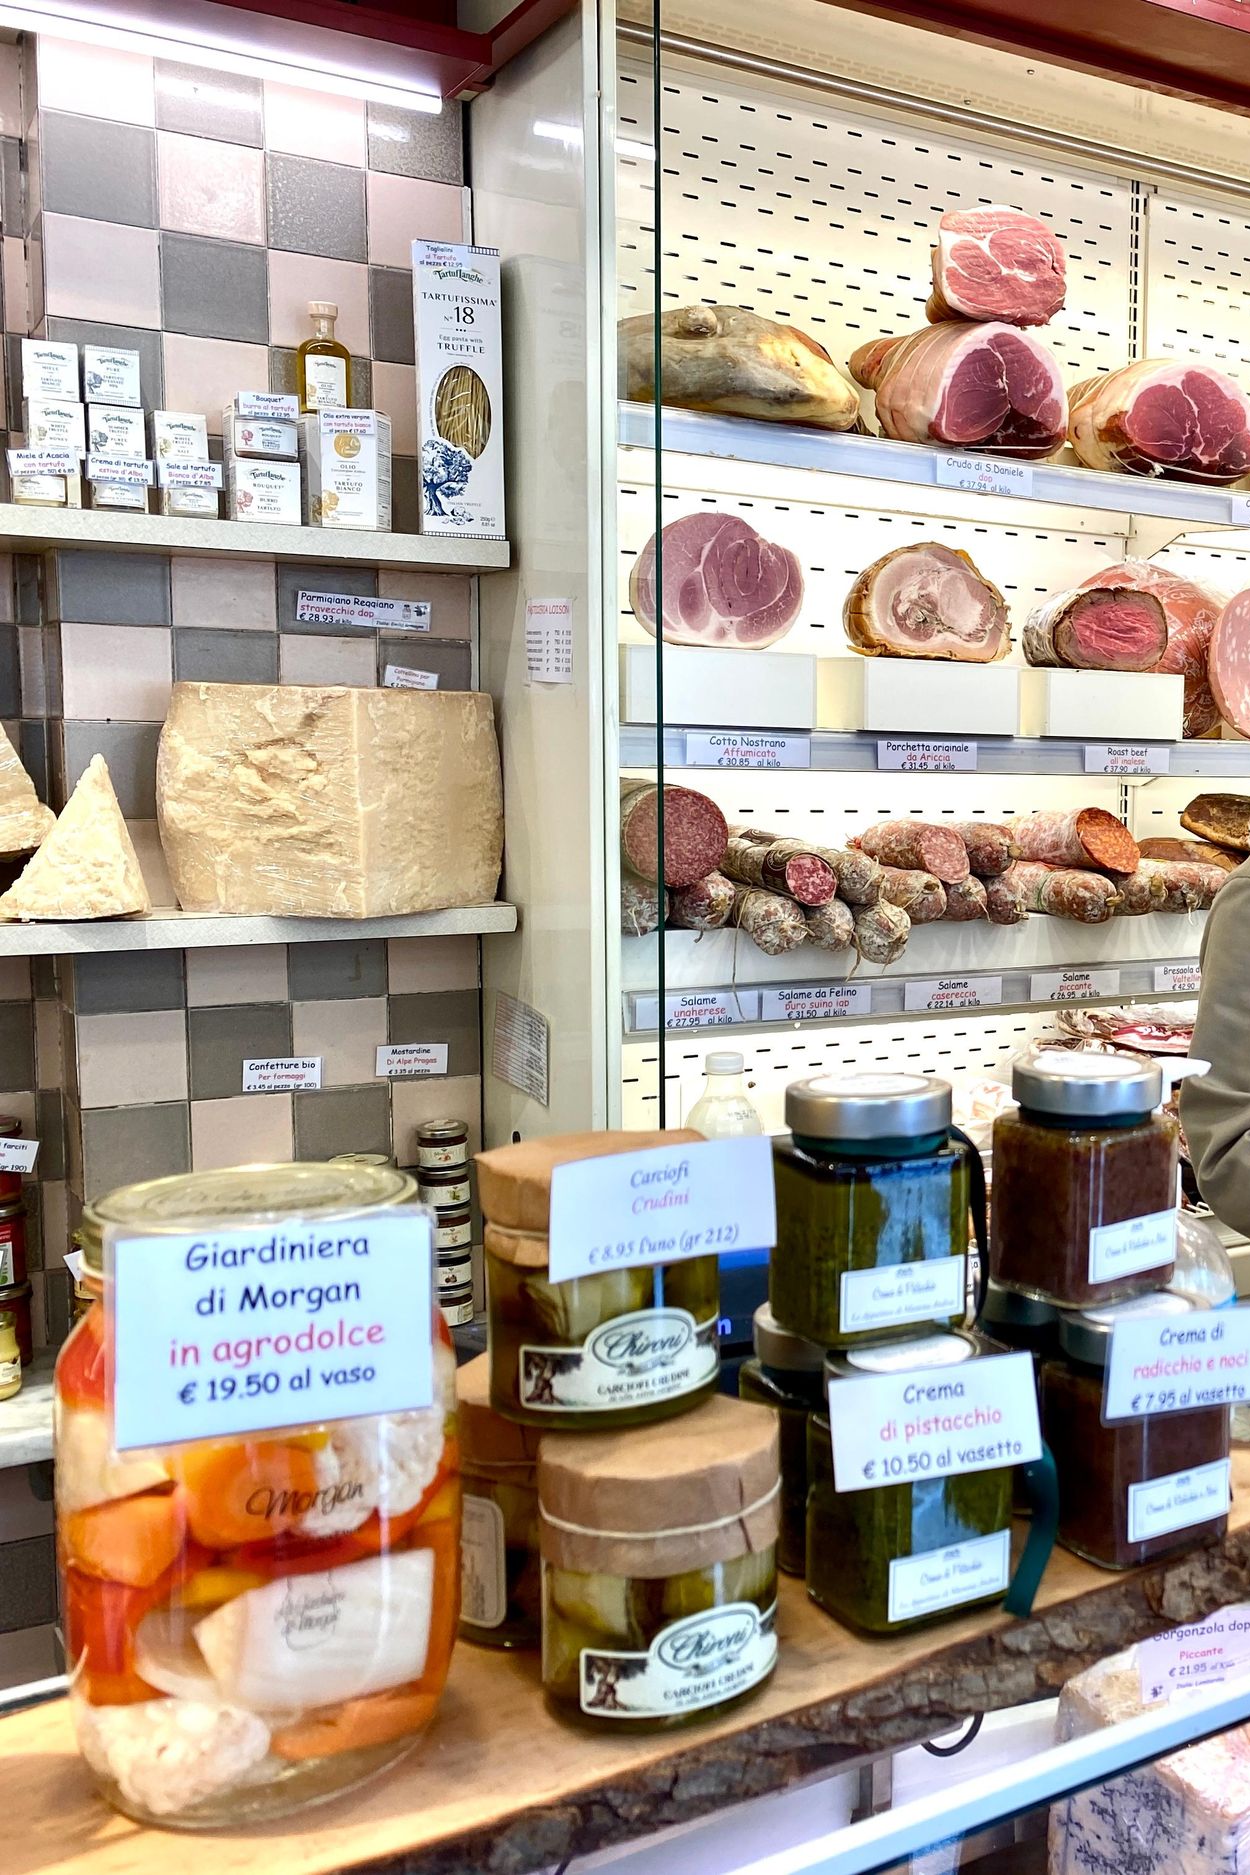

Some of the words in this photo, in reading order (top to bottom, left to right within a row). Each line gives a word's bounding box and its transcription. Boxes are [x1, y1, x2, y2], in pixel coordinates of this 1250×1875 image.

[454, 306, 475, 324] 18
[437, 343, 485, 354] TRUFFLE
[271, 403, 295, 412] tartufo
[91, 458, 113, 466] Crema
[123, 461, 148, 469] tartufo
[946, 458, 972, 469] Crudo
[975, 461, 982, 471] di
[985, 463, 1024, 477] S.Daniele
[978, 474, 992, 483] dop
[967, 481, 987, 490] 37.94
[300, 592, 350, 606] Parmigiano
[353, 597, 394, 610] Reggiano
[300, 604, 355, 616] stravecchio
[357, 608, 374, 619] dop
[308, 613, 334, 623] 28.93
[709, 736, 737, 746] Cotto
[740, 737, 786, 748] Nostrano
[886, 742, 930, 751] Porchetta
[933, 743, 969, 752] originale
[723, 747, 776, 758] Affumicato
[1107, 747, 1128, 756] Roast
[1131, 748, 1148, 756] beef
[726, 758, 750, 766] 30.85
[766, 759, 780, 767] kilo
[907, 753, 917, 761] da
[920, 753, 950, 762] Ariccia
[908, 762, 928, 770] 31.45
[1163, 965, 1193, 975] Bresaola
[1062, 973, 1090, 982] Salame
[938, 980, 968, 990] Salame
[1059, 983, 1092, 991] piccante
[778, 990, 812, 1000] Salame
[815, 989, 826, 998] da
[829, 987, 857, 997] Felino
[931, 991, 976, 1000] casereccio
[1057, 991, 1075, 999] 26.95
[680, 996, 717, 1006] Salame
[809, 1000, 833, 1009] suino
[934, 1000, 953, 1009] 22.14
[968, 998, 980, 1006] kilo
[674, 1007, 726, 1018] ungherese
[795, 1010, 817, 1019] 31.50
[833, 1008, 846, 1016] kilo
[675, 1017, 700, 1027] 27.95
[718, 1015, 732, 1023] kilo
[391, 1047, 431, 1055] Mostardine
[249, 1062, 299, 1071] Confetture
[302, 1060, 316, 1069] bio
[413, 1057, 437, 1065] Pragas
[273, 1072, 306, 1082] formaggi
[630, 1160, 690, 1188] Carciofi
[631, 1188, 690, 1215] Crudini
[588, 1250, 599, 1265] €
[601, 1244, 635, 1262] 8.95
[679, 1231, 700, 1253] (gr
[704, 1223, 739, 1243] 212)
[186, 1234, 369, 1272] Giardiniera
[196, 1288, 226, 1316] di
[238, 1281, 361, 1314] Morgan
[1159, 1327, 1206, 1346] Crema
[1210, 1321, 1225, 1341] di
[169, 1339, 200, 1367] in
[213, 1319, 385, 1369] agrodolce
[1133, 1358, 1201, 1379] radicchio
[1206, 1359, 1215, 1371] e
[1219, 1349, 1249, 1367] noci
[178, 1382, 197, 1405] €
[208, 1372, 280, 1402] 19.50
[289, 1367, 311, 1391] al
[321, 1365, 376, 1387] vaso
[903, 1381, 965, 1404] Crema
[1144, 1390, 1176, 1409] 7.95
[1180, 1388, 1192, 1406] al
[1196, 1384, 1245, 1401] vasetto
[880, 1420, 897, 1442] di
[904, 1408, 1002, 1443] pistacchio
[863, 1460, 875, 1480] €
[882, 1453, 931, 1478] 10.50
[936, 1449, 952, 1468] al
[957, 1439, 1022, 1465] vasetto
[246, 1480, 364, 1519] Morgan
[1228, 1618, 1250, 1637] dop
[1179, 1645, 1223, 1660] Piccante
[1179, 1663, 1207, 1676] 21.95
